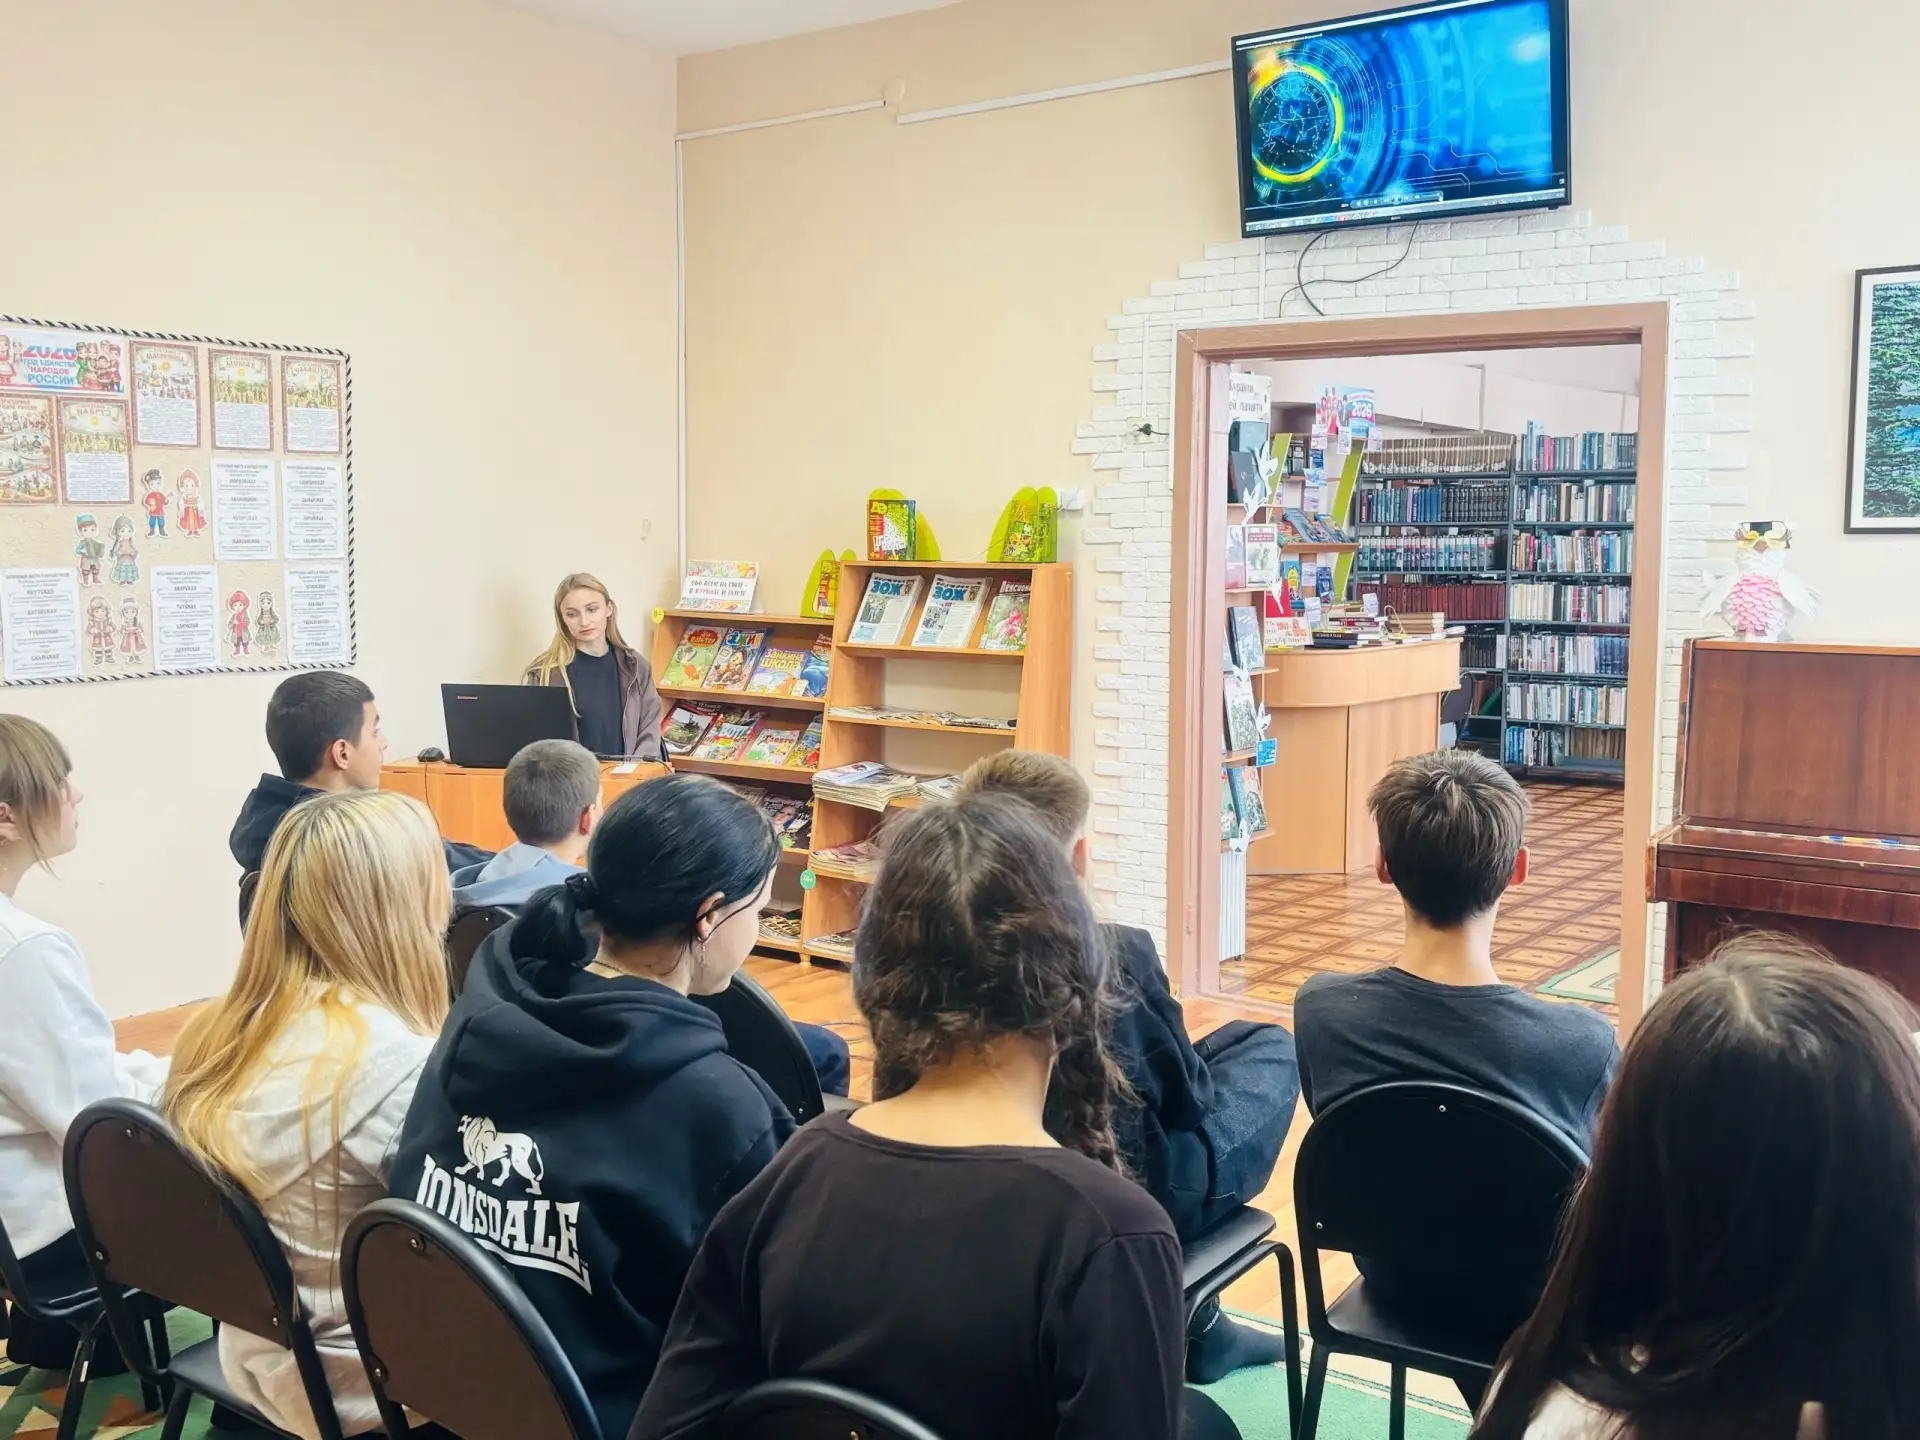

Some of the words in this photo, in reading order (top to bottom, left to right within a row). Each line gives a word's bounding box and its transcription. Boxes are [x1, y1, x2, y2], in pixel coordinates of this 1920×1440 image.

[30, 367, 70, 375] НАРОДОВ
[27, 374, 74, 385] РОССИИ
[1352, 402, 1372, 418] 2026
[871, 580, 904, 595] ЗОЖ
[932, 586, 968, 601] ЗОЖ
[764, 648, 805, 661] Зайкина
[415, 1153, 584, 1276] LONSDALE
